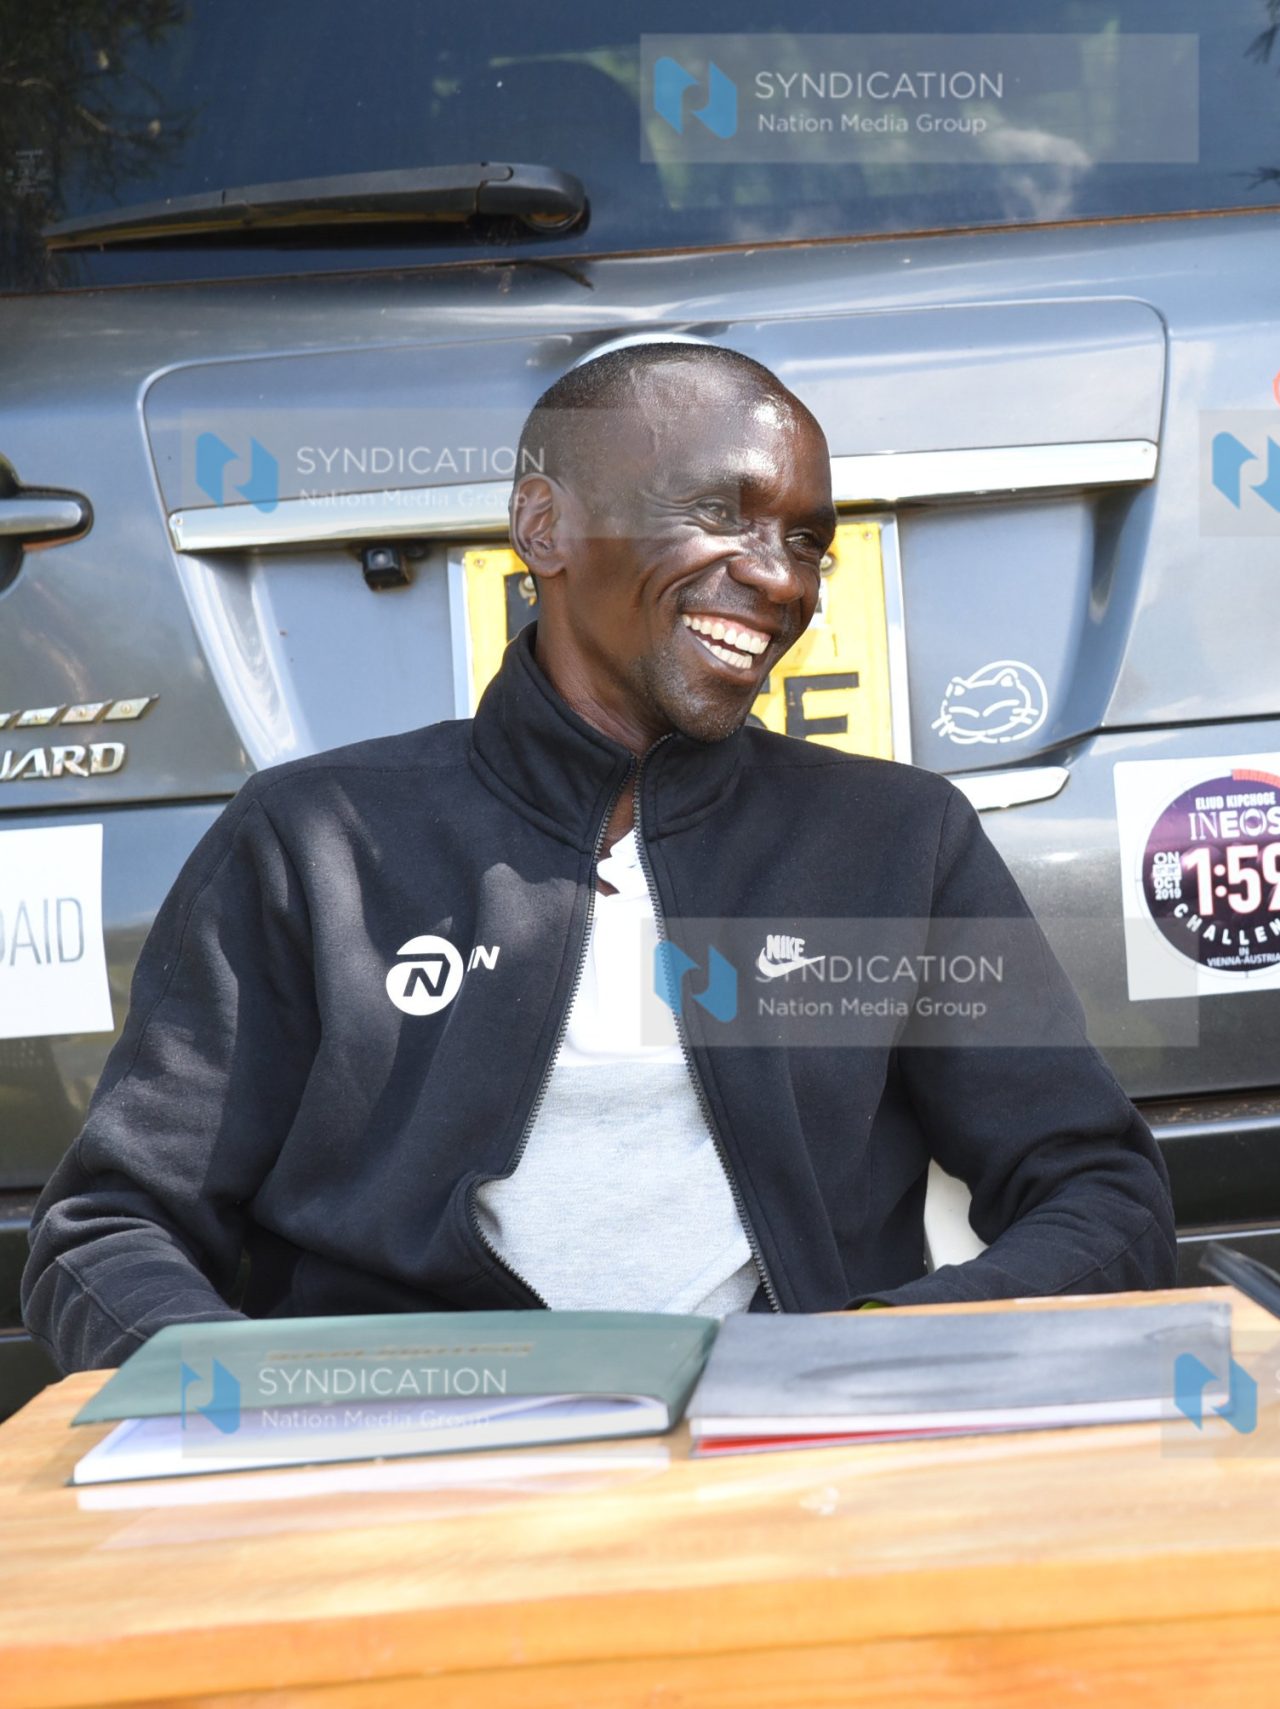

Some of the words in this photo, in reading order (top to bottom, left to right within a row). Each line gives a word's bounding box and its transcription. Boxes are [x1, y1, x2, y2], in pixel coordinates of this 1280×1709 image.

[1153, 851, 1180, 865] ON
[1153, 876, 1181, 889] OCT
[1154, 888, 1182, 901] 2019
[0, 896, 85, 967] AID
[766, 934, 805, 961] NIKE
